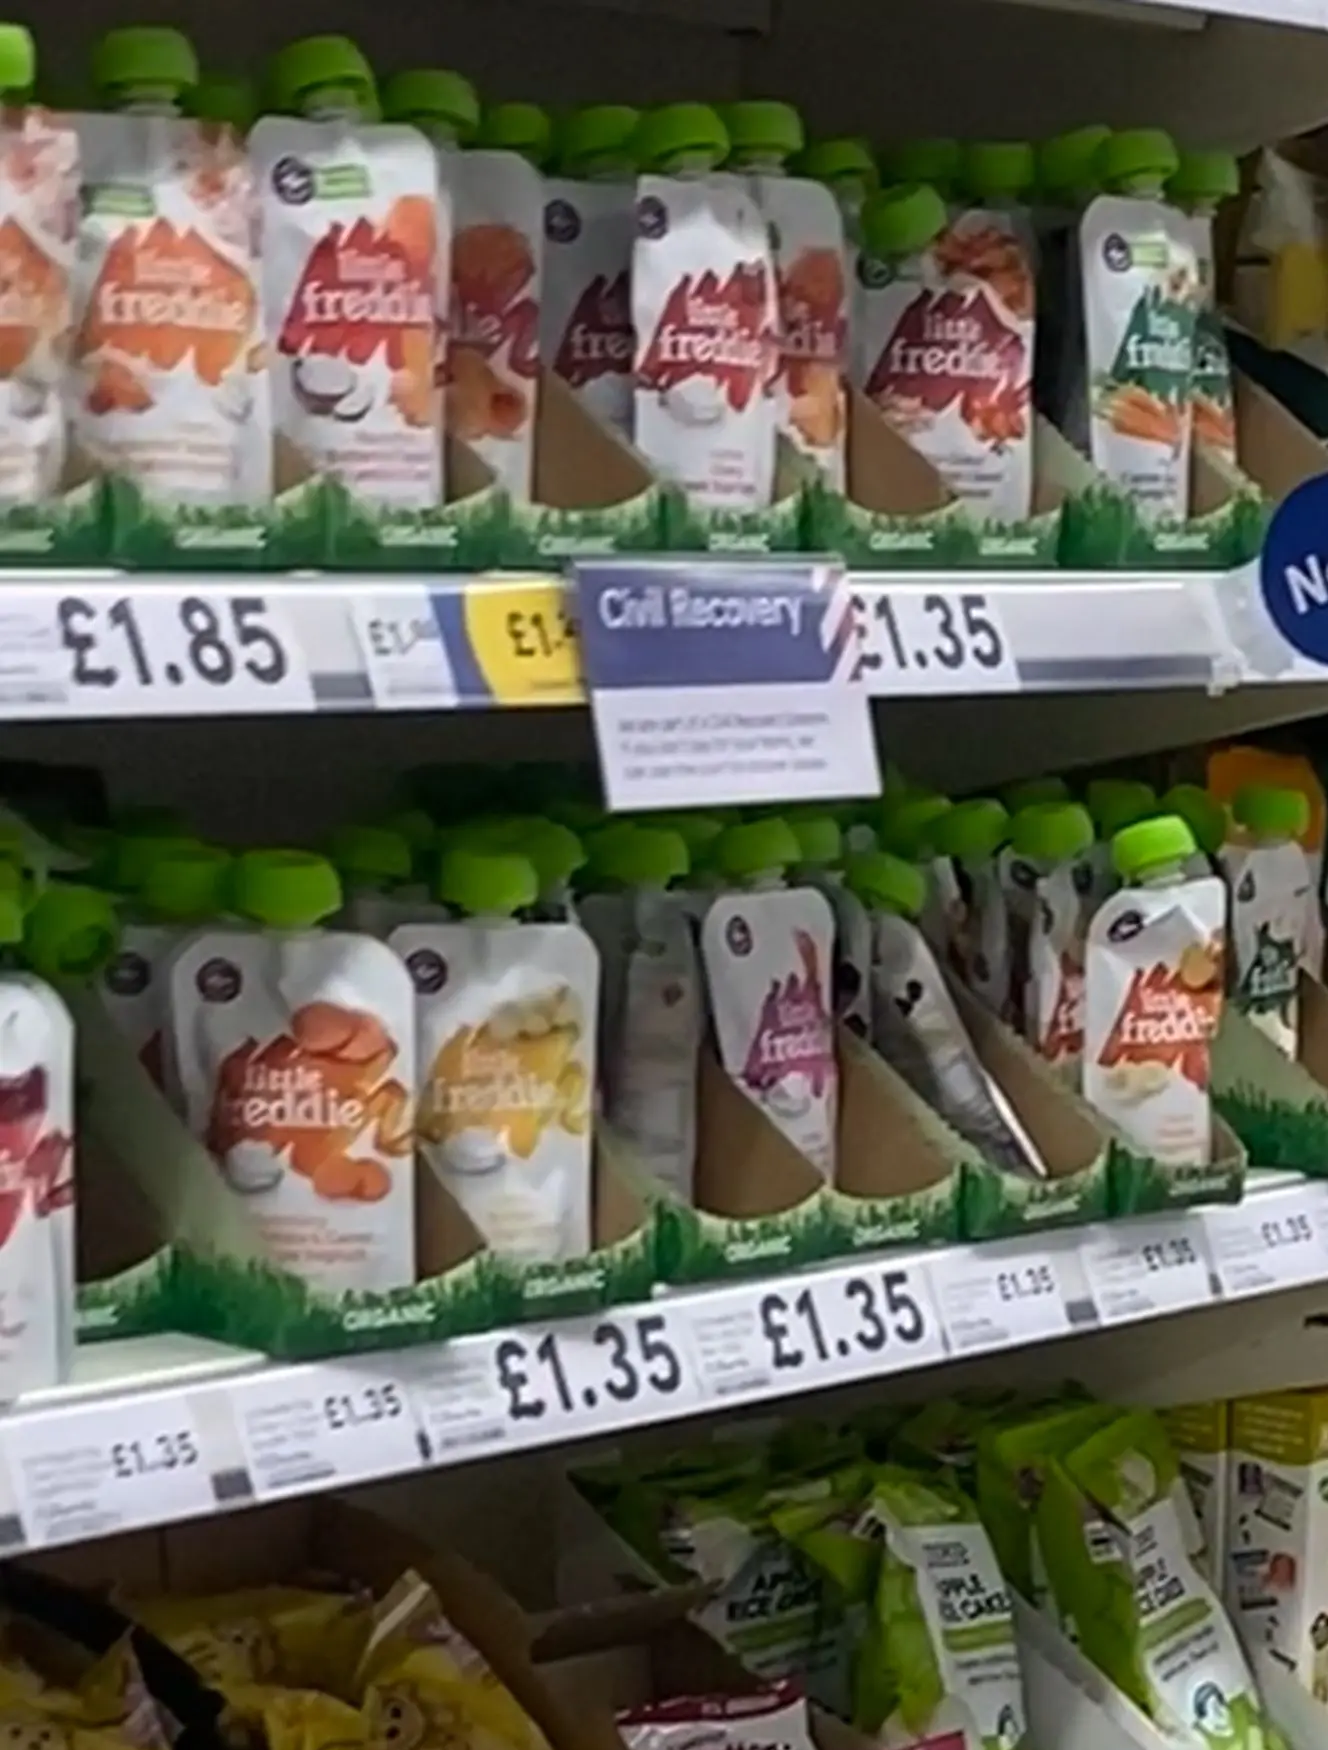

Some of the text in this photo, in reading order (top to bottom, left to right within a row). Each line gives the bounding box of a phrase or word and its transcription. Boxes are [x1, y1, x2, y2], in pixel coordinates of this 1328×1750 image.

[601, 590, 805, 638] Civil Recovery
[57, 594, 289, 688] £1.85
[849, 594, 1003, 682] £1.35
[724, 1236, 792, 1263] ORGANIC
[852, 1220, 921, 1247] ORGANIC
[1261, 1213, 1314, 1252] £1.35
[1144, 1236, 1198, 1275] £1.35
[523, 1269, 608, 1300] ORGANIC
[997, 1265, 1054, 1302] £1.35
[341, 1304, 437, 1333] ORGANIC
[761, 1271, 926, 1370] £1.35
[497, 1314, 684, 1421] £1.35
[323, 1382, 403, 1430] £1.35
[110, 1430, 199, 1479] £1.35
